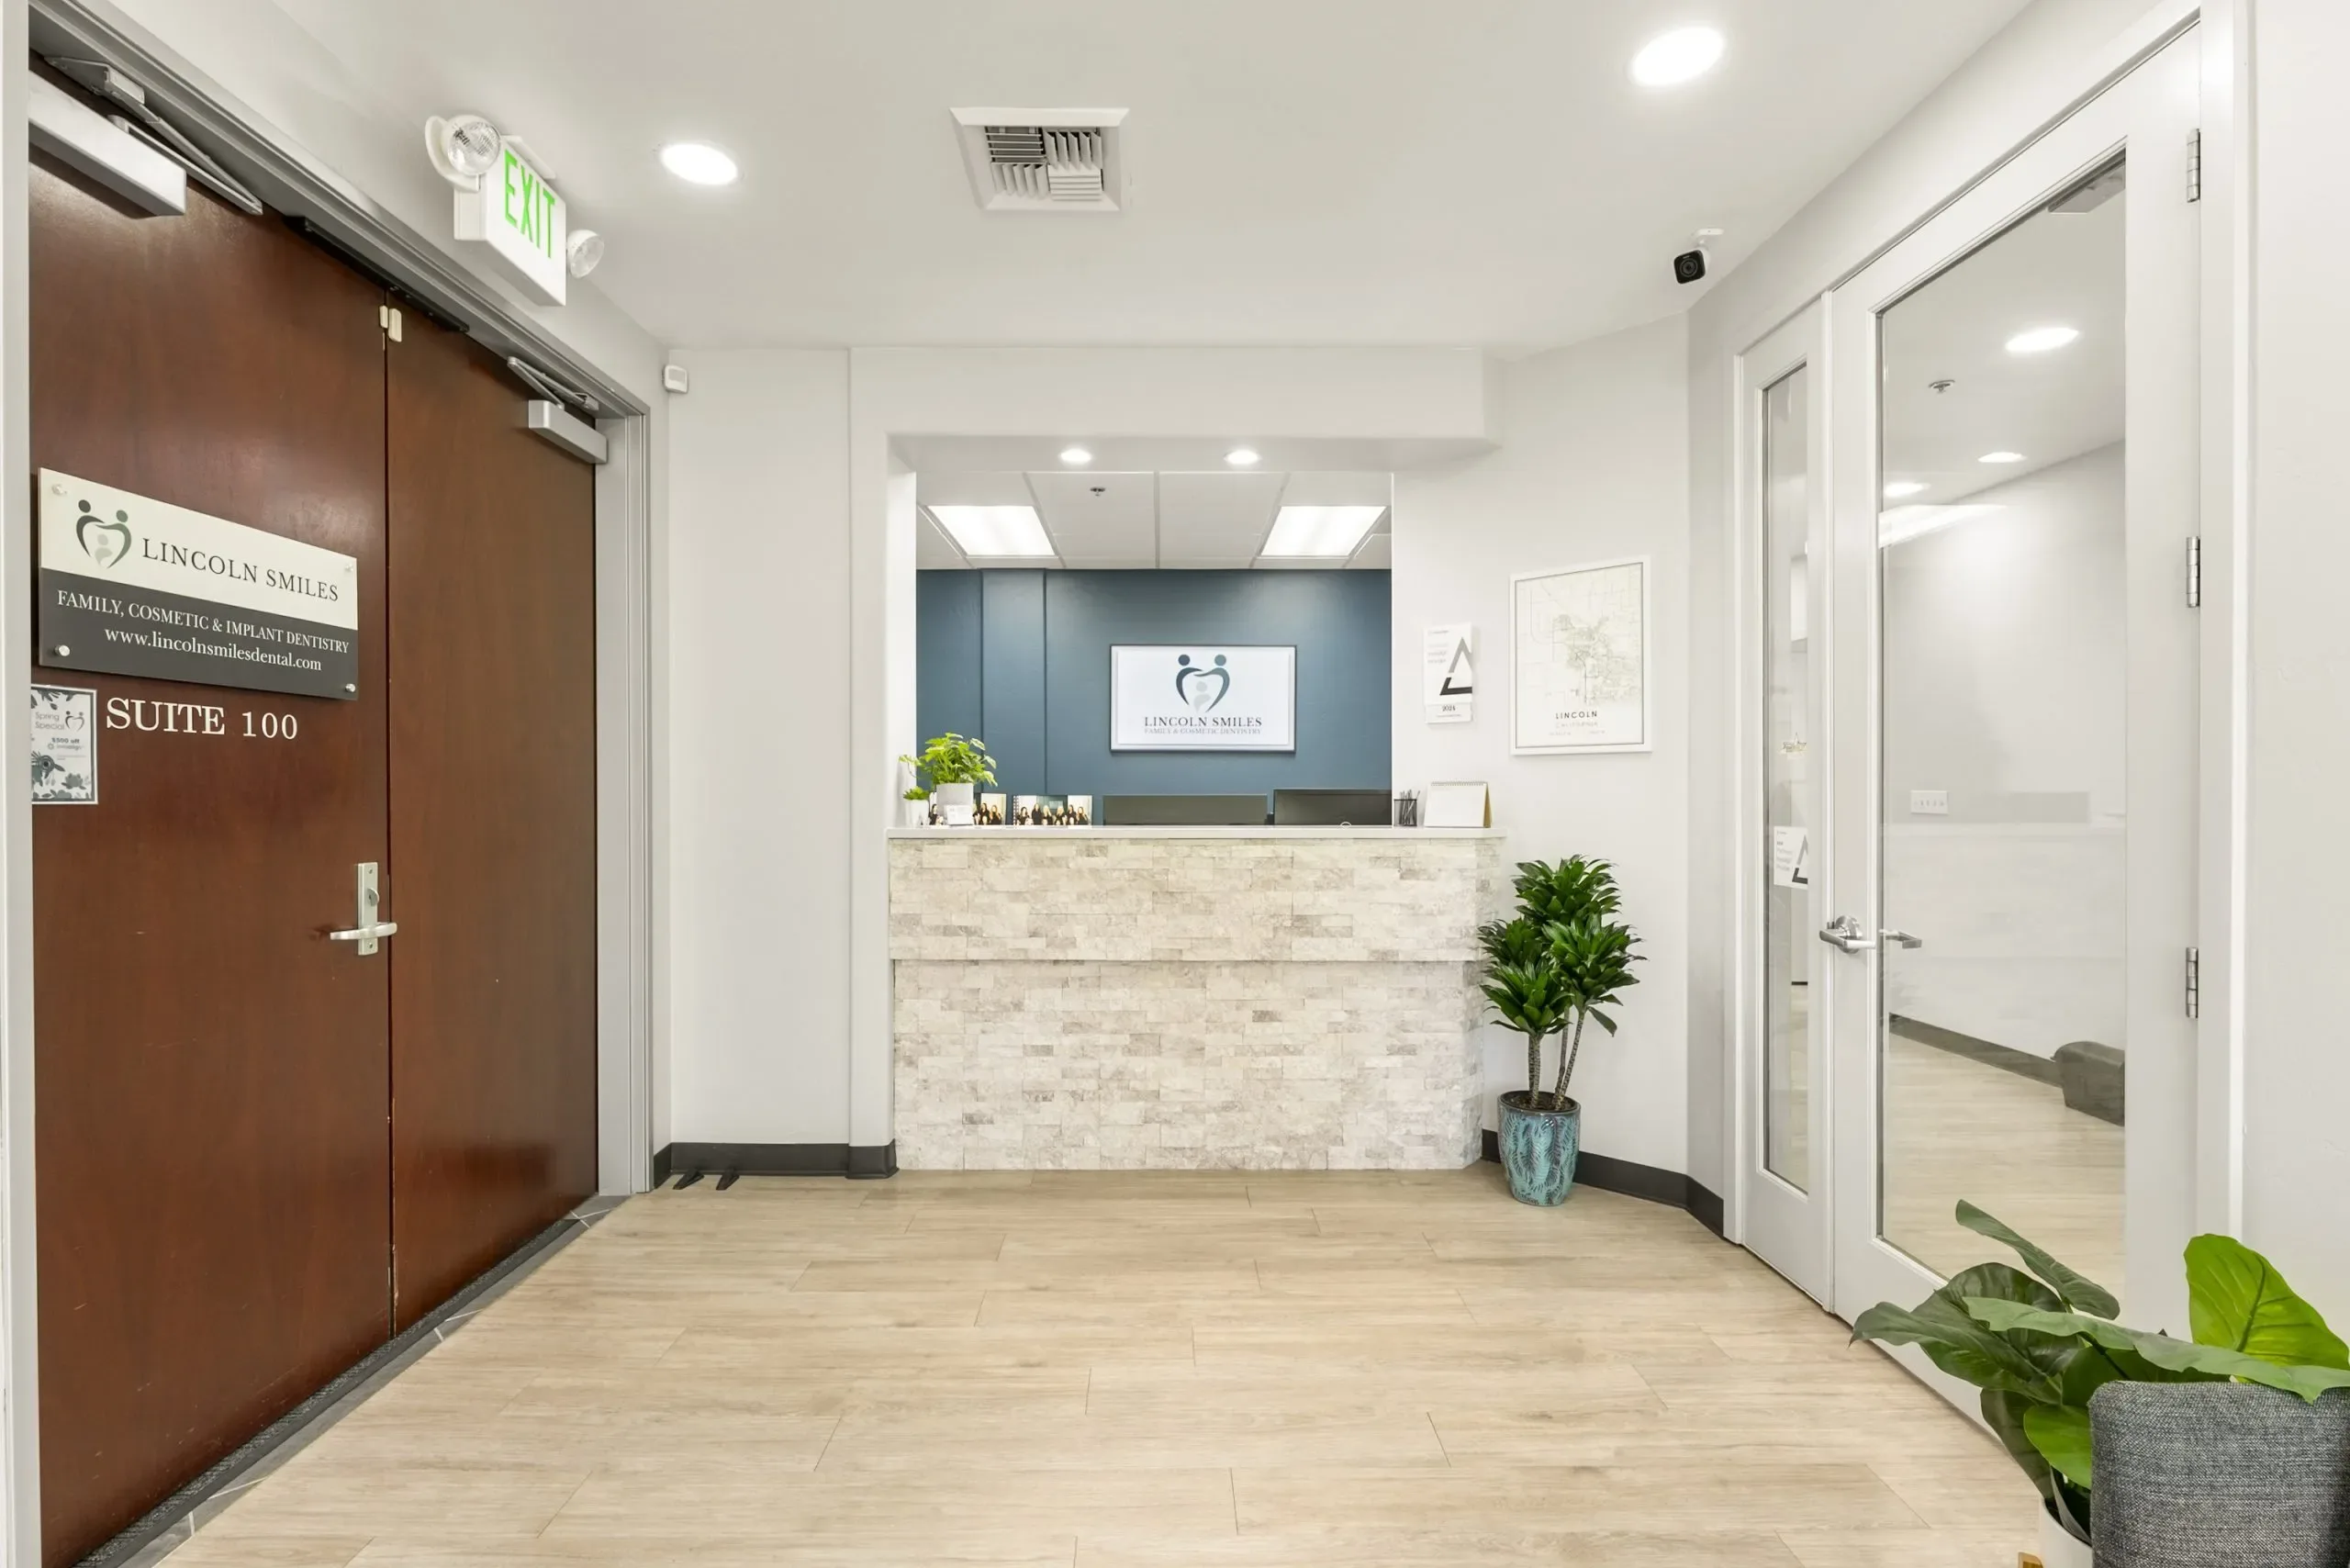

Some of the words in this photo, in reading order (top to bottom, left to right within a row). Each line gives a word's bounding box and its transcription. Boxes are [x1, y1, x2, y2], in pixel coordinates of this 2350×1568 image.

[504, 149, 555, 259] EXIT
[141, 537, 258, 584] LINCOLN
[265, 568, 339, 602] SMILES
[57, 588, 125, 618] FAMILY,
[128, 602, 209, 631] COSMETIC
[212, 617, 223, 633] &
[226, 620, 285, 643] IMPLANT
[286, 631, 350, 654] DENTISTRY
[104, 628, 322, 671] www.lincolnsmilesdental.com
[35, 711, 60, 722] Spring
[35, 721, 65, 731] Special
[106, 697, 226, 735] SUITE
[241, 711, 298, 740] 100
[1144, 716, 1208, 727] LINCOLN
[1212, 716, 1262, 727] SMILES
[1555, 710, 1597, 720] LINCOLN
